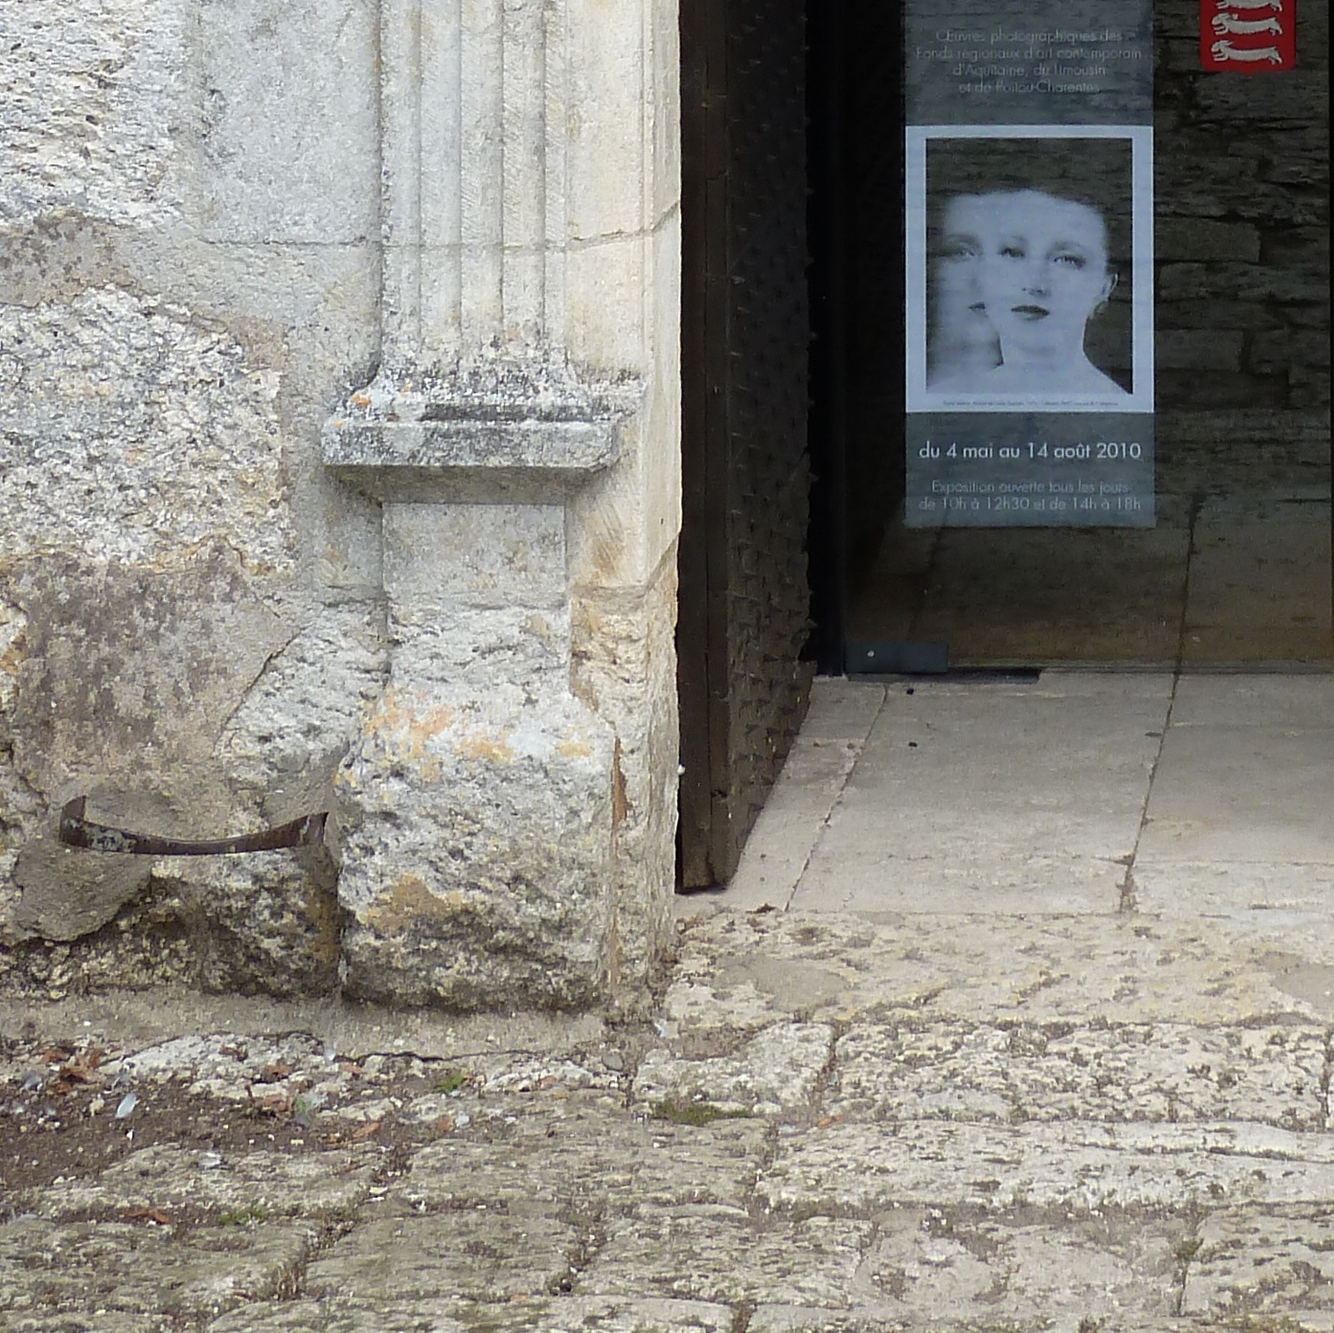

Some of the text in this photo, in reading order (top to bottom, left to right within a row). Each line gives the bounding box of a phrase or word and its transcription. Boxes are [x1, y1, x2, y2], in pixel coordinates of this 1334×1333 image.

[990, 26, 1097, 45] photographiques
[1099, 26, 1123, 42] des
[1056, 47, 1142, 63] contemporain
[1033, 63, 1051, 77] du
[918, 441, 1142, 460] du 4 mai au 14 août 2010
[931, 480, 1129, 496] Exposition ouverte tous les jours
[918, 496, 1142, 511] de 10h à 12h30 et de 14h à 18h
